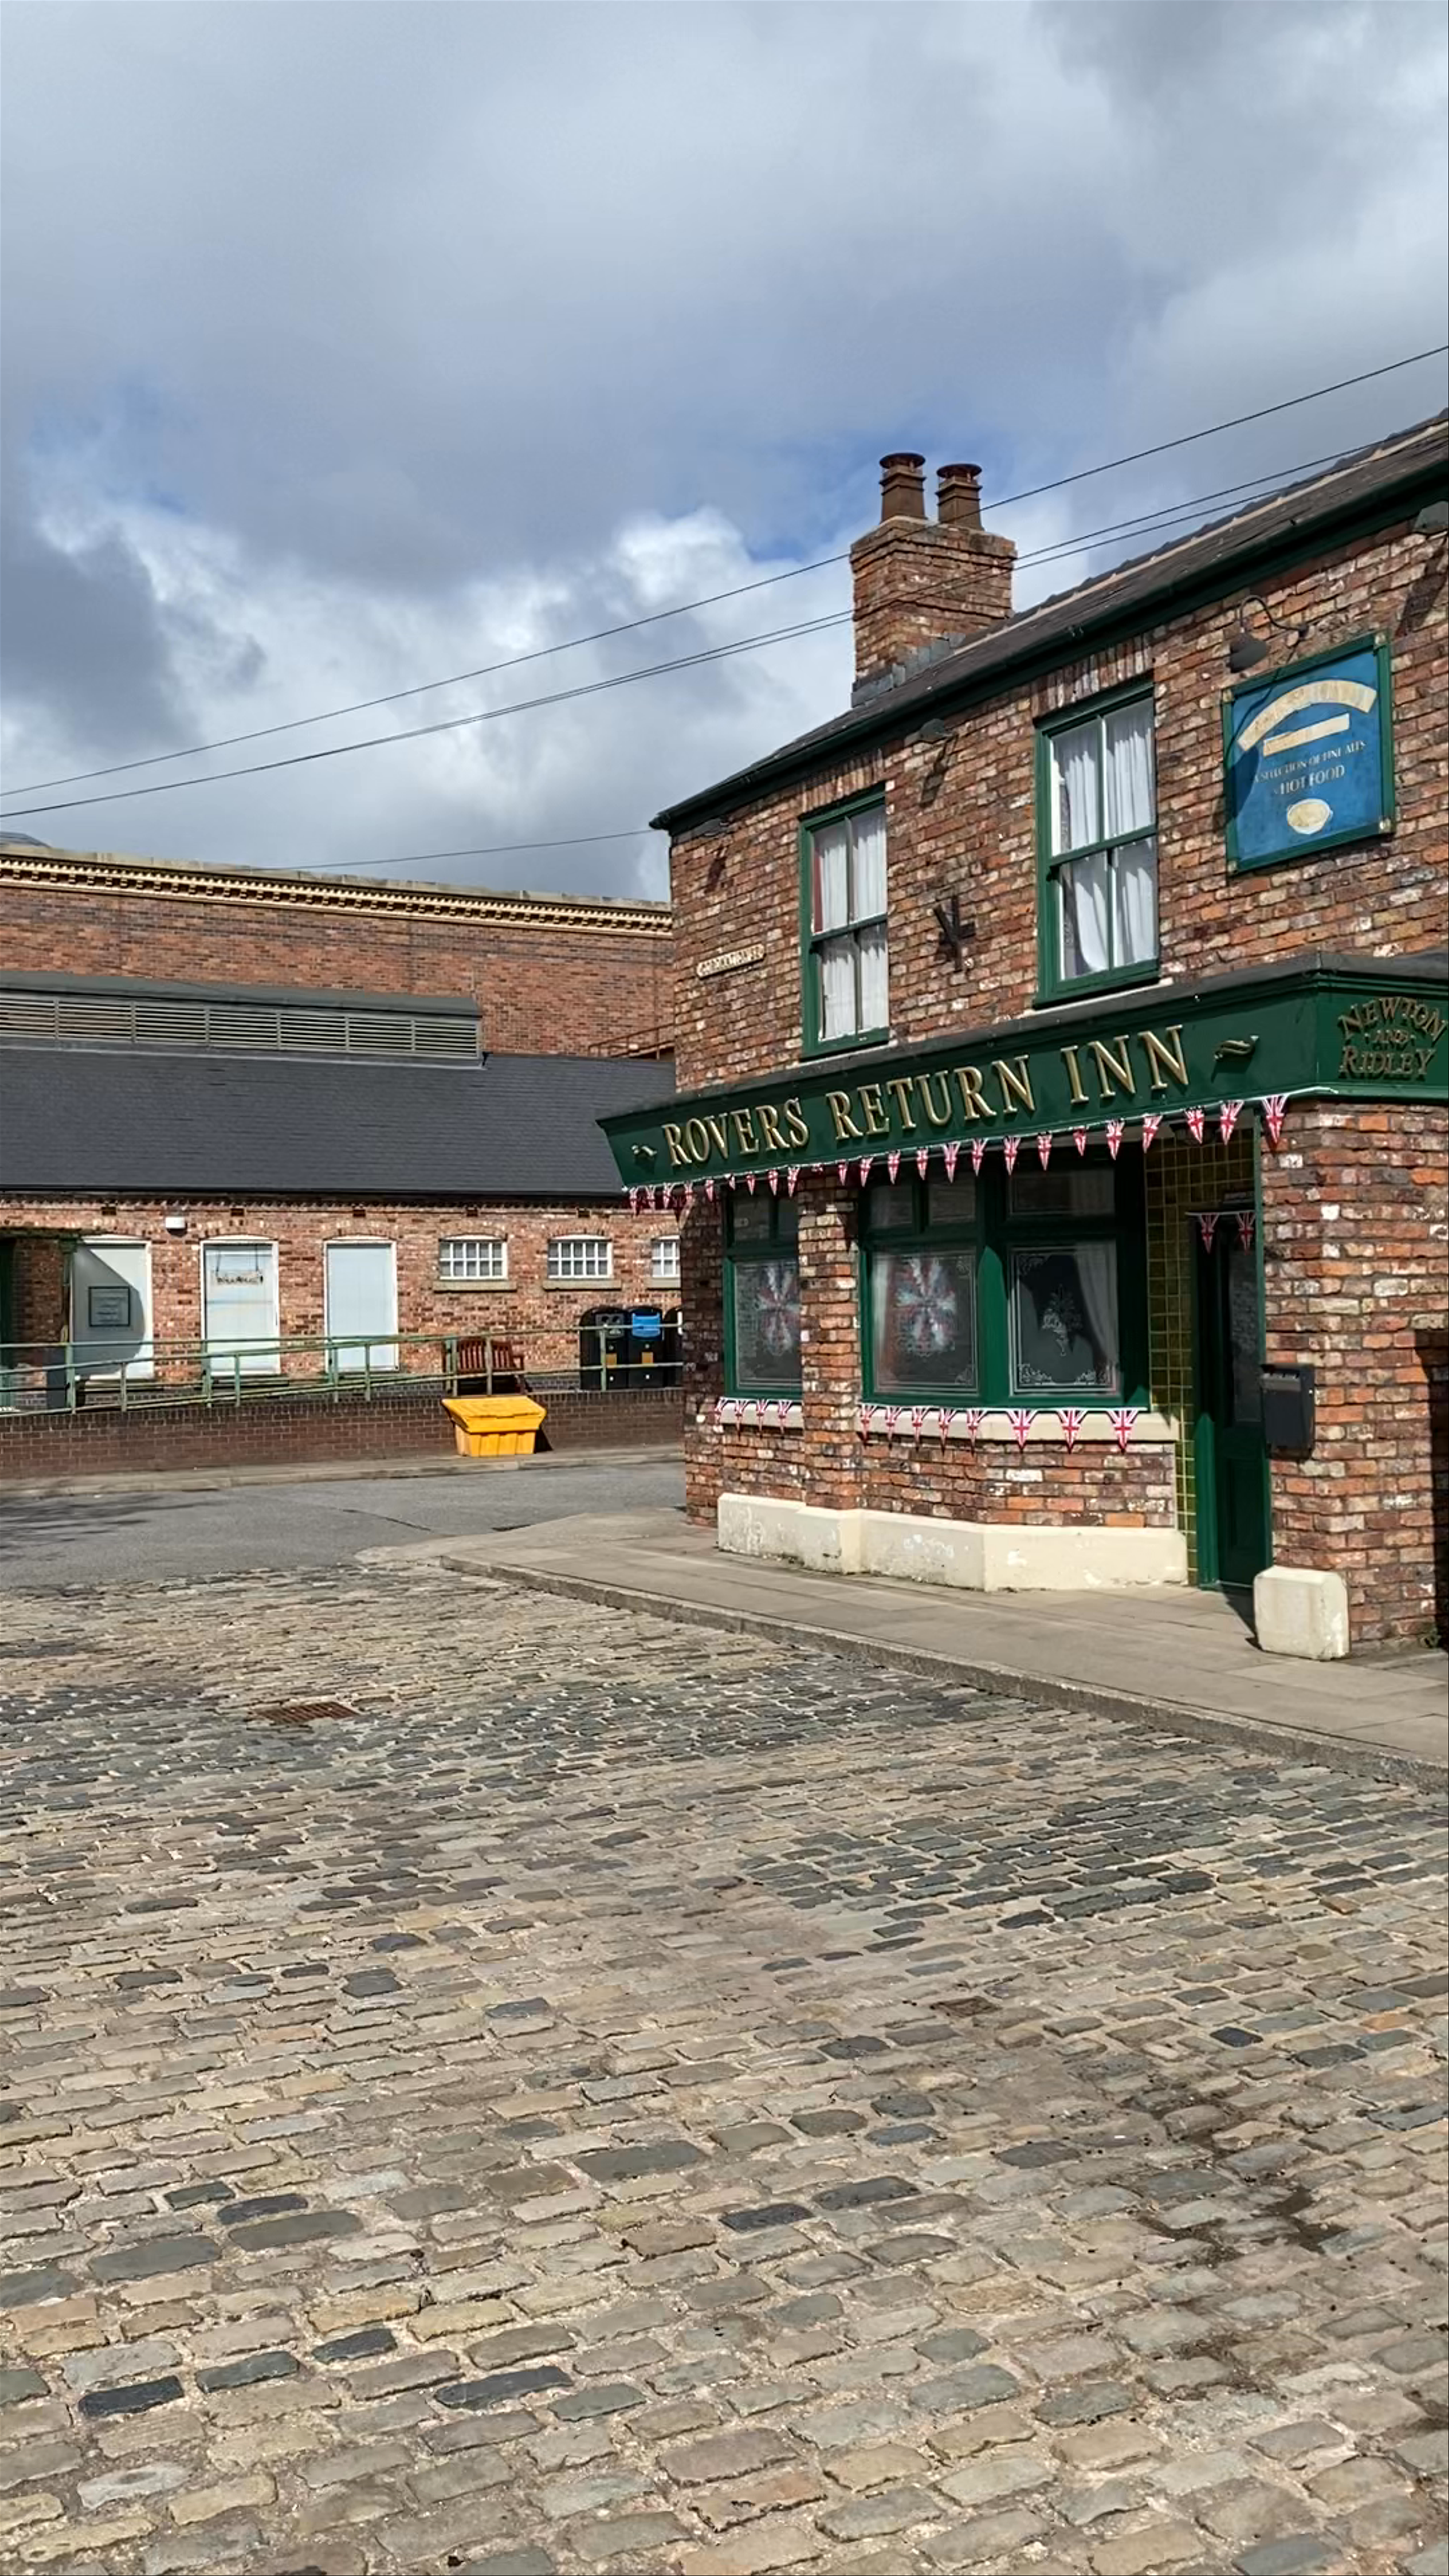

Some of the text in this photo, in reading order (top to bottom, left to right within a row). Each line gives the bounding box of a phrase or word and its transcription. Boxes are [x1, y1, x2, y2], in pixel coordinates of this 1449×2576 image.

[1280, 764, 1346, 795] HOT FOOD
[1338, 996, 1448, 1041] NEWTON
[1374, 1029, 1410, 1044] AND
[1338, 1045, 1436, 1075] RIDLEY
[661, 1024, 1189, 1166] ROVERS RETURN INN
